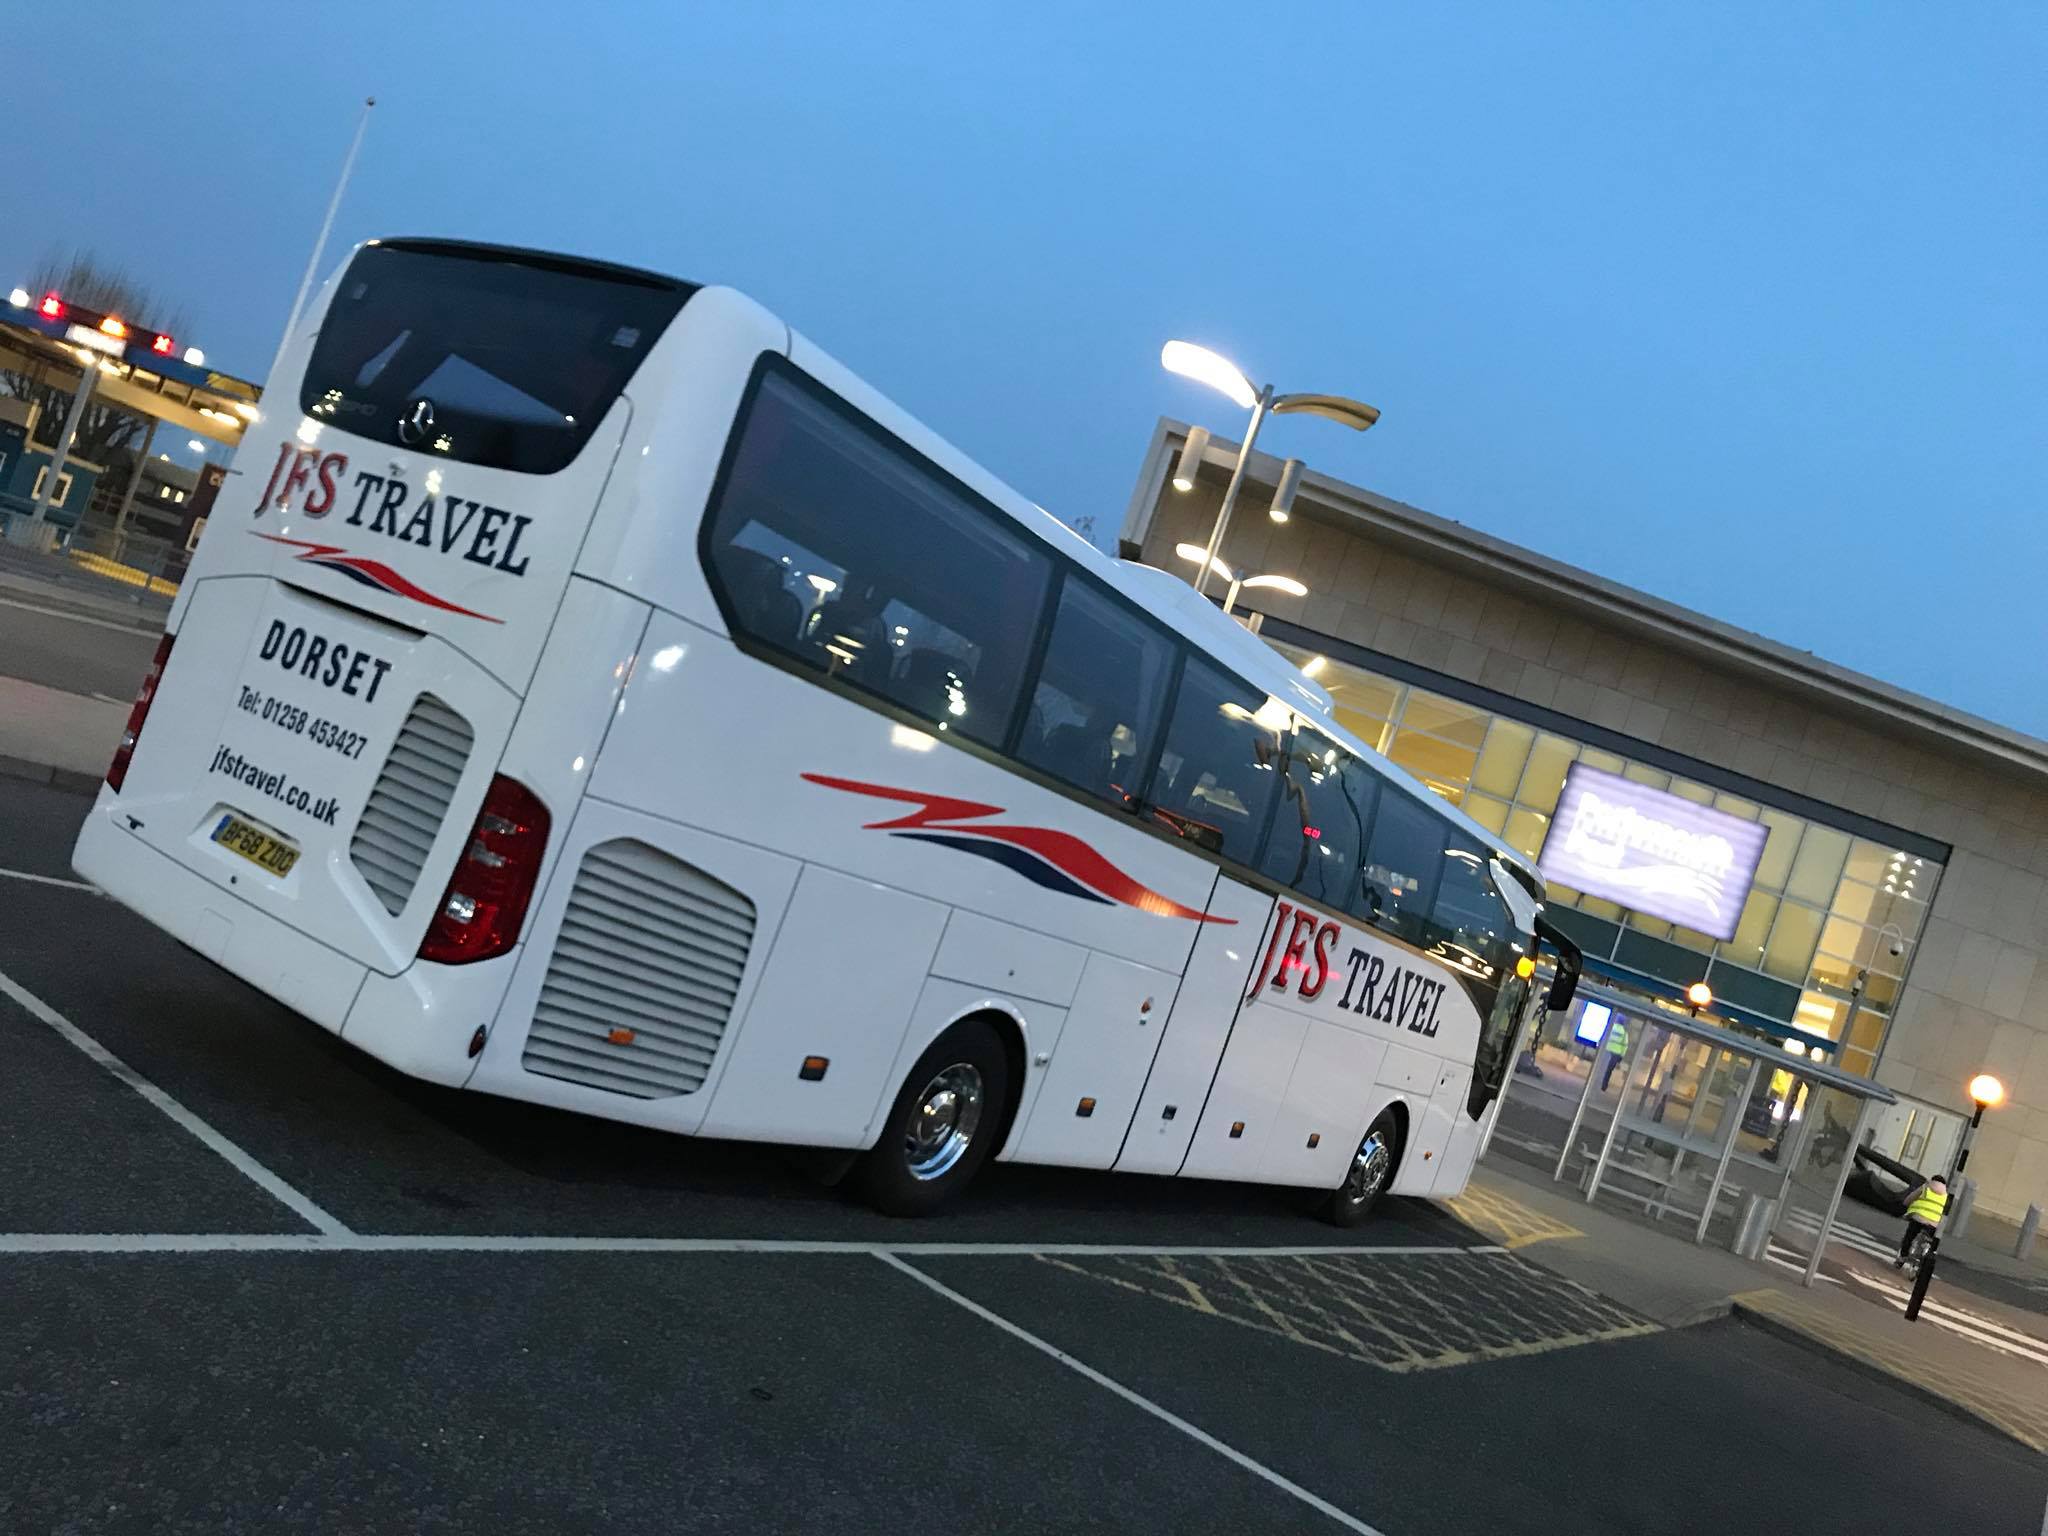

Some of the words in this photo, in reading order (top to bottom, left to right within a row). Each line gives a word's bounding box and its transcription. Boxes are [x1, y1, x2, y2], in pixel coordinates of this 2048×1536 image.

[254, 441, 348, 519] JFS
[346, 471, 533, 577] TRAVEL
[259, 618, 392, 704] DORSET
[238, 685, 262, 715] Tel:
[262, 697, 309, 734] 01258
[308, 718, 368, 760] 453427
[209, 744, 340, 826] jfstravel.co.uk
[1246, 901, 1342, 1007] JFS
[1337, 948, 1446, 1039] TRAVEL
